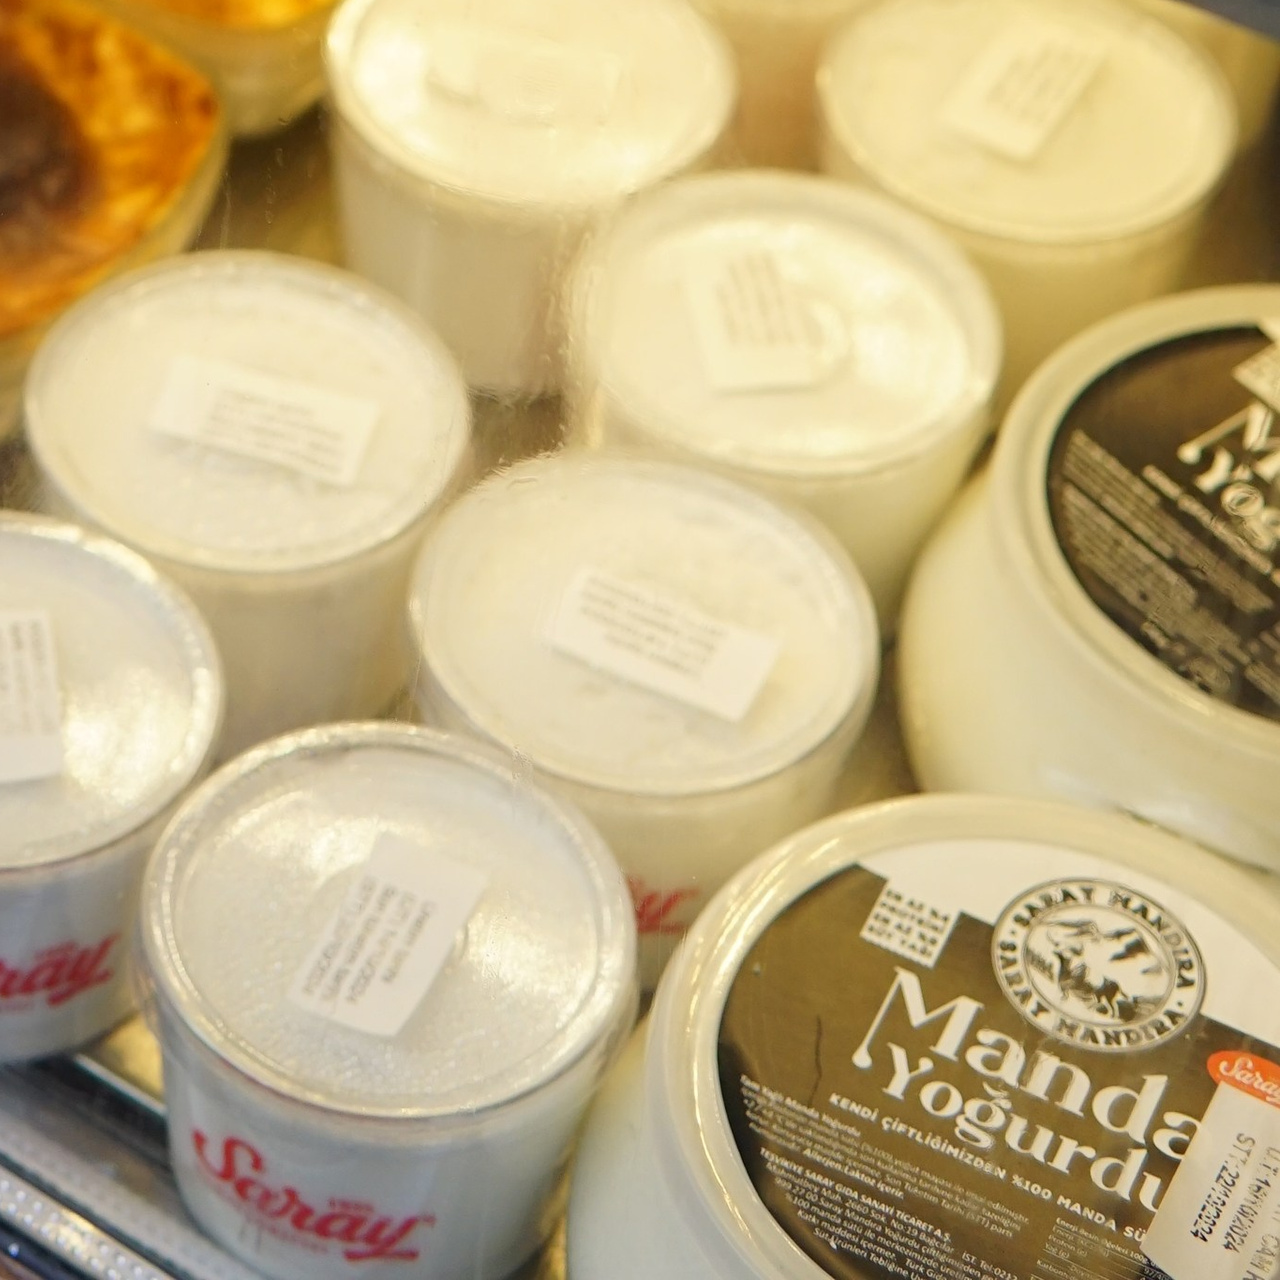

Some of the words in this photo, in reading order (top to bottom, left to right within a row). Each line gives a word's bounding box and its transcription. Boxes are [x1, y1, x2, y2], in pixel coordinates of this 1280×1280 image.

[852, 966, 1203, 1161] Manda
[190, 1127, 421, 1266] Saray
[805, 1169, 834, 1188] SARAY
[835, 1183, 860, 1199] GIDA
[830, 1091, 877, 1120] KENDİ
[1057, 1196, 1118, 1230] MANDA
[811, 1204, 841, 1223] manda
[818, 1197, 843, 1215] Saray
[882, 1227, 920, 1250] Yoğurdu
